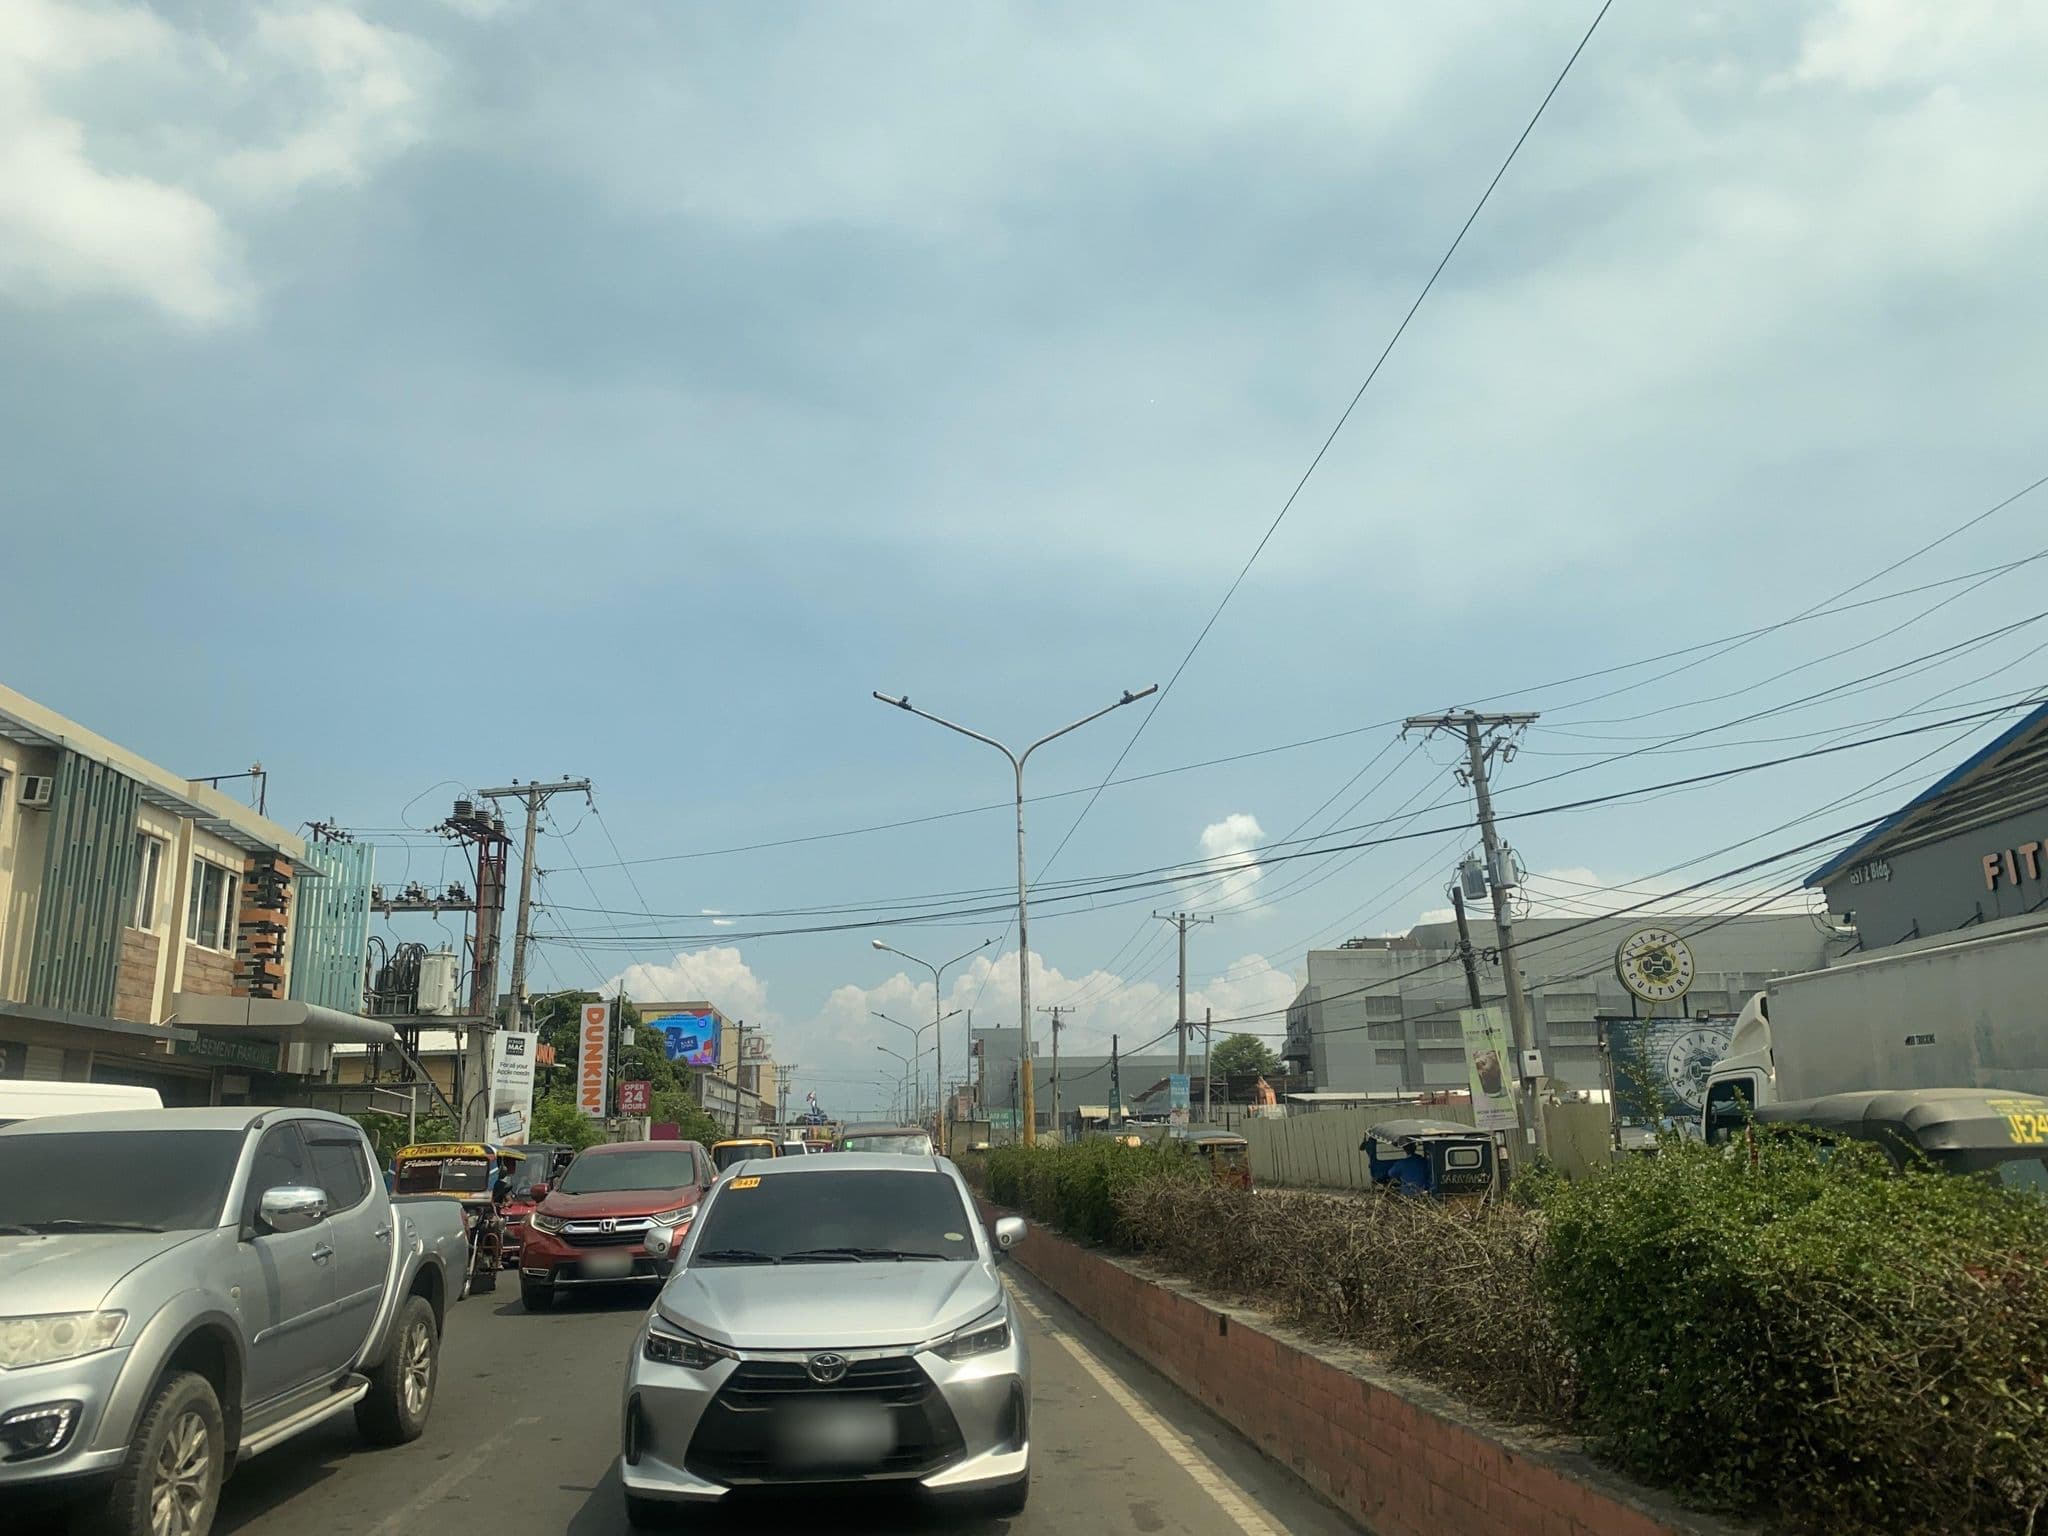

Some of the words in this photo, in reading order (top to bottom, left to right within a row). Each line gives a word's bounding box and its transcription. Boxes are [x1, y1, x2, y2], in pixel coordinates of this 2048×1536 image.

[1983, 840, 2048, 891] FIT
[1628, 970, 1690, 996] CULTURE
[188, 1039, 236, 1057] BASEMENT
[507, 1044, 525, 1052] MAC
[582, 1007, 605, 1113] DUNKIN'
[624, 1091, 644, 1103] 24
